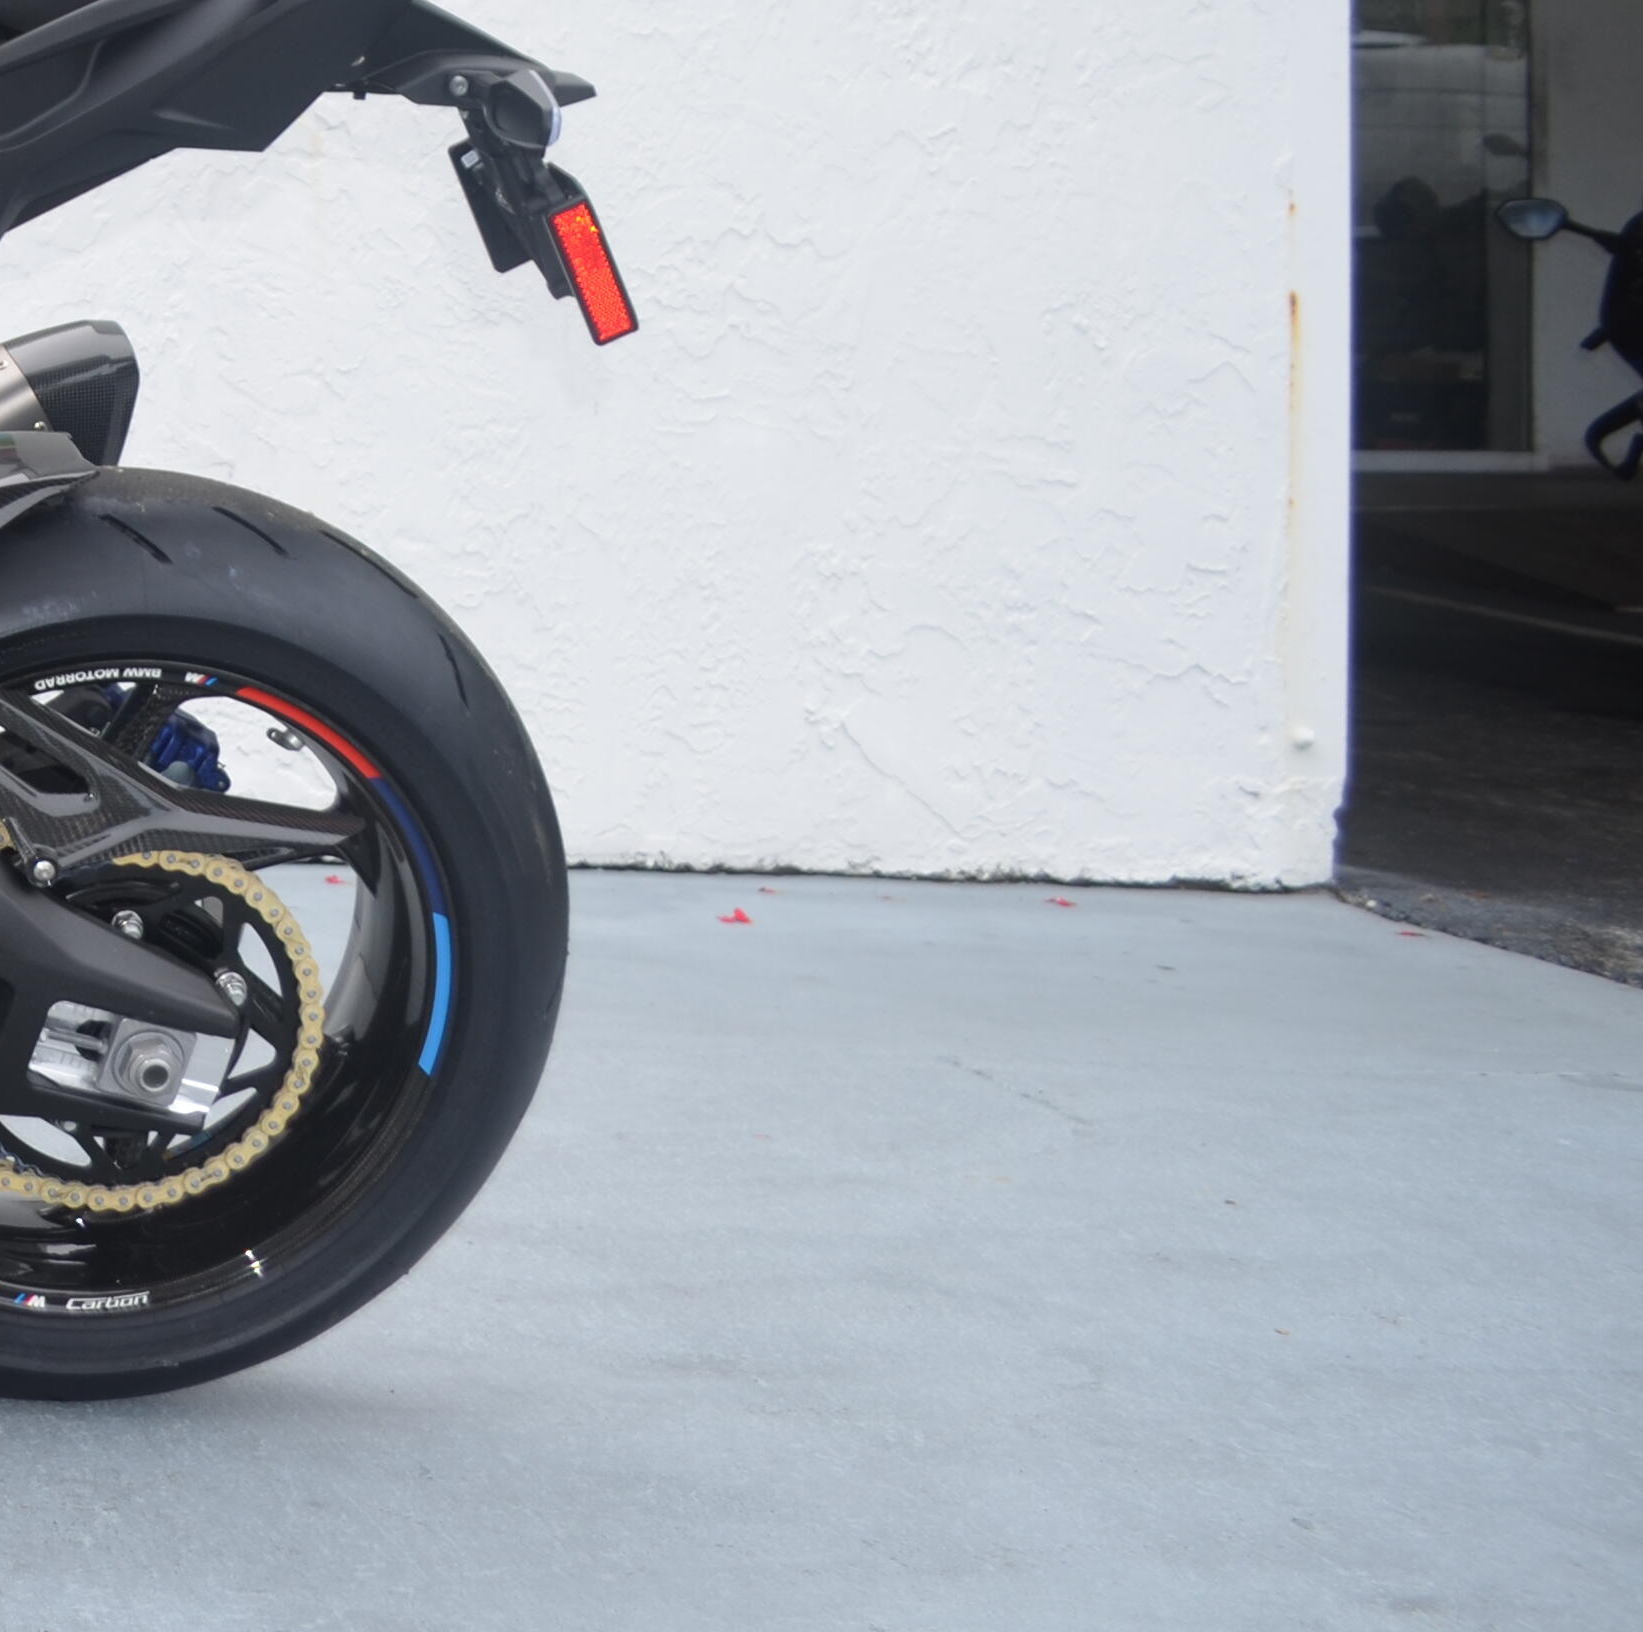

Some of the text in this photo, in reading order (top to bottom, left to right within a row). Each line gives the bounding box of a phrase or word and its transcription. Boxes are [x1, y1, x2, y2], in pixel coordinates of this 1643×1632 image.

[34, 667, 163, 691] BMW MOTORRAD
[66, 1290, 151, 1311] Carbon
